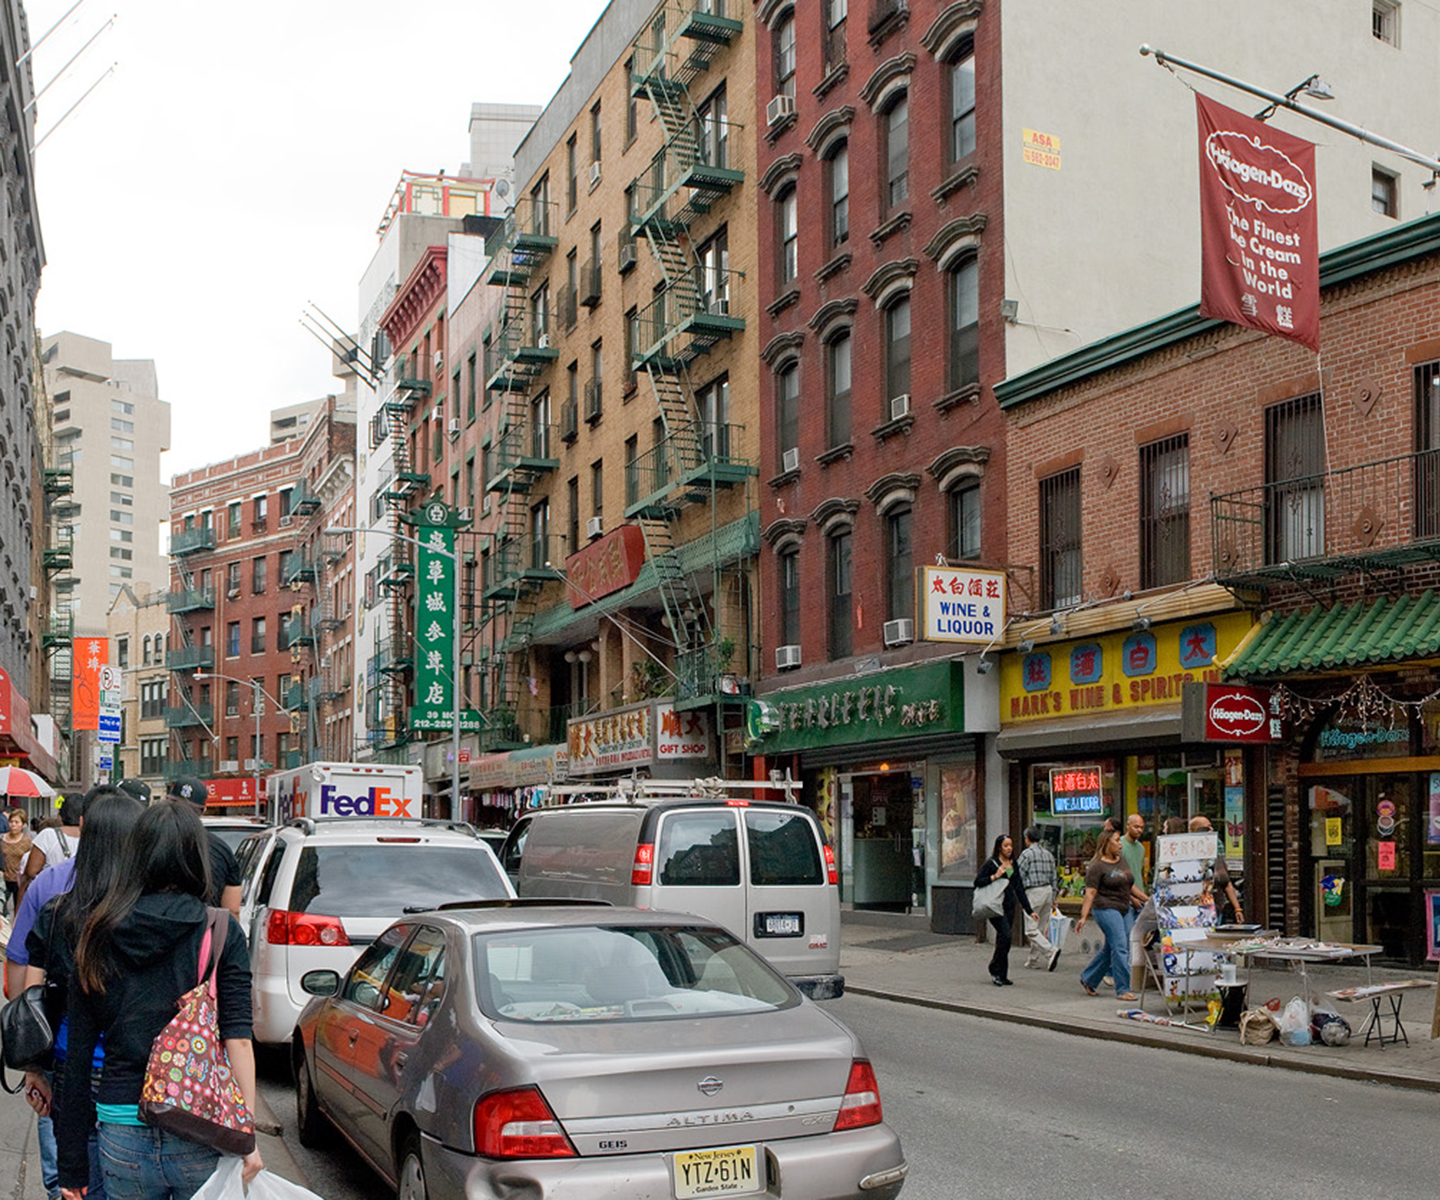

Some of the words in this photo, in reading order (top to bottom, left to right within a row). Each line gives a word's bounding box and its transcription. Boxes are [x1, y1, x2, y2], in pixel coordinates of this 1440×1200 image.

[1209, 142, 1307, 200] Häagen-Dazs
[1226, 205, 1249, 231] The
[1254, 213, 1301, 246] Finest
[1250, 238, 1301, 264] Cream
[1241, 252, 1255, 271] in
[1260, 259, 1288, 281] the
[1243, 269, 1293, 300] World
[940, 601, 977, 618] WINE
[982, 605, 991, 618] &
[937, 619, 994, 636] LIQUOR
[1010, 691, 1062, 718] MARK'S
[1069, 684, 1105, 710] WINE
[1112, 683, 1122, 704] &
[427, 711, 439, 720] 39
[442, 711, 468, 720] MOT
[1212, 706, 1264, 723] Häagen-Dazs
[660, 744, 679, 755] GIFT
[682, 743, 706, 754] SHOP
[320, 784, 413, 818] FedEx
[667, 1111, 754, 1127] ALTIMA
[599, 1140, 628, 1150] GEIS
[694, 1152, 711, 1161] New
[712, 1150, 735, 1161] Jersey
[696, 1184, 718, 1194] Garden
[720, 1182, 738, 1192] State
